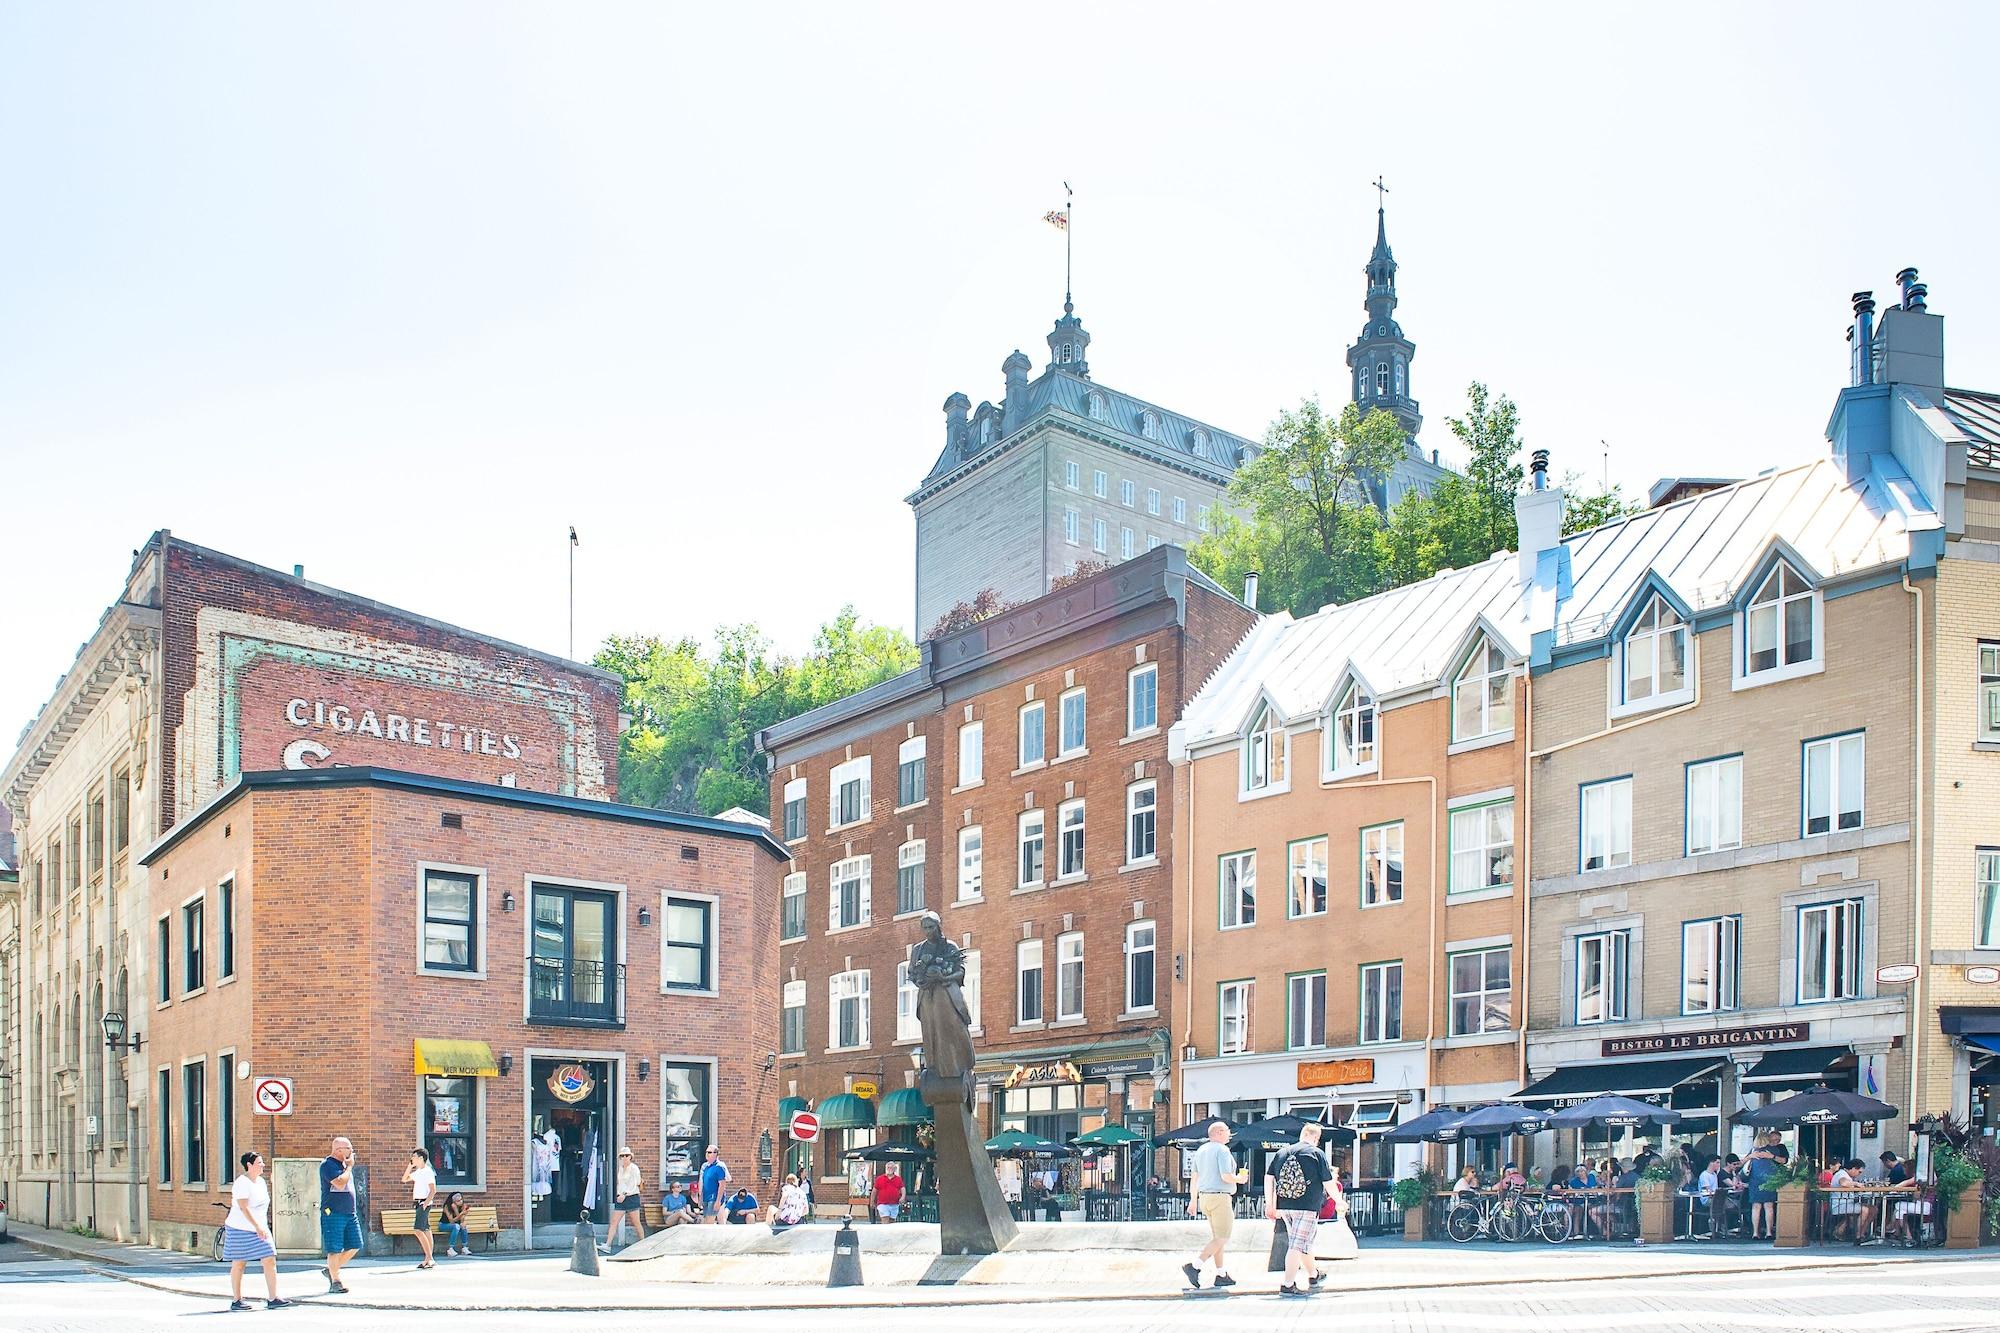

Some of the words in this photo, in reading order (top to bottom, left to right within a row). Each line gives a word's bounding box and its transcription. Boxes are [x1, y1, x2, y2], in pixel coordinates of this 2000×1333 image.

[284, 697, 523, 760] CIGARETTES
[1611, 1038, 1664, 1050] BISTRO
[1671, 1036, 1690, 1048] LE
[1697, 1027, 1799, 1046] BRIGANTIN
[443, 1066, 457, 1074] MER
[459, 1066, 479, 1074] MODE
[1554, 1100, 1565, 1108] LE
[1862, 1126, 1875, 1134] 97
